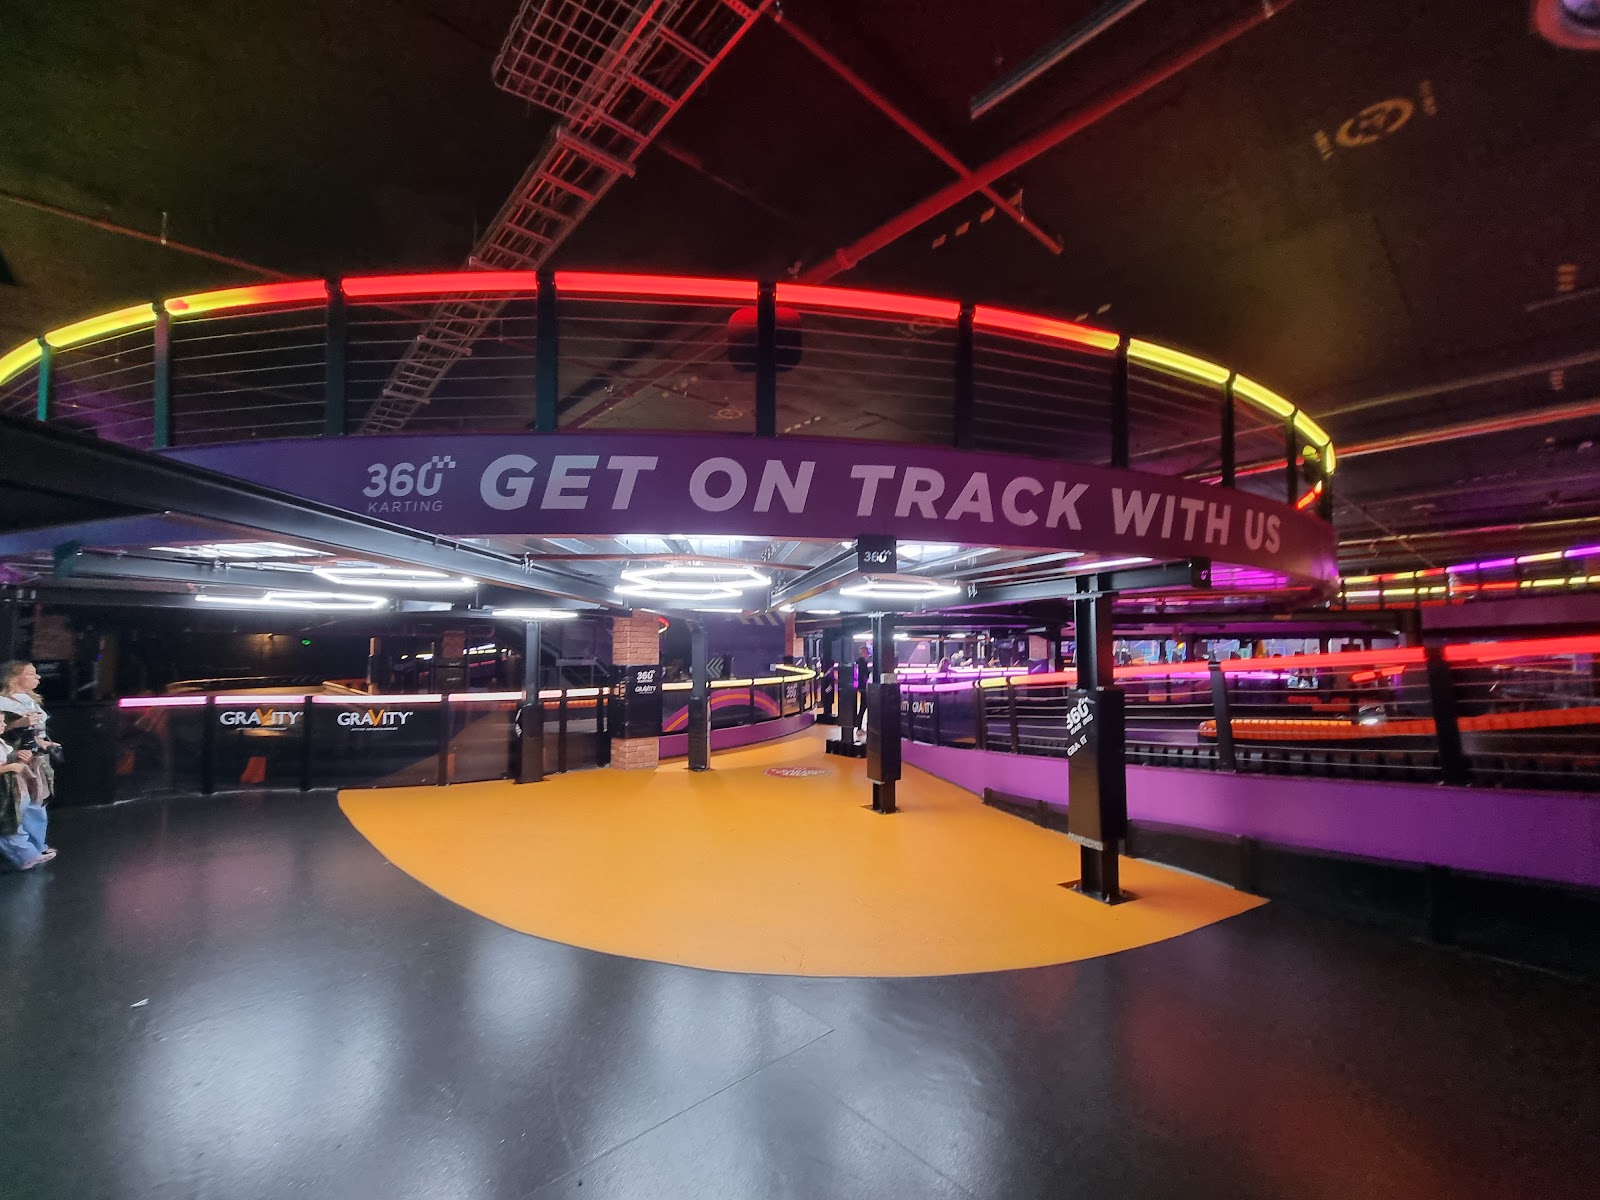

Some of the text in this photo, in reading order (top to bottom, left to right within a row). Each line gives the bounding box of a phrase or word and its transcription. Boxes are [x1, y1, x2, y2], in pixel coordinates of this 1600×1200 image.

[363, 455, 456, 498] 360
[368, 500, 443, 513] KARTING
[479, 454, 1282, 555] GET ON TRACK WITH US
[636, 669, 656, 681] 360
[219, 708, 304, 726] GRAVITY
[337, 708, 414, 727] GRAVITY
